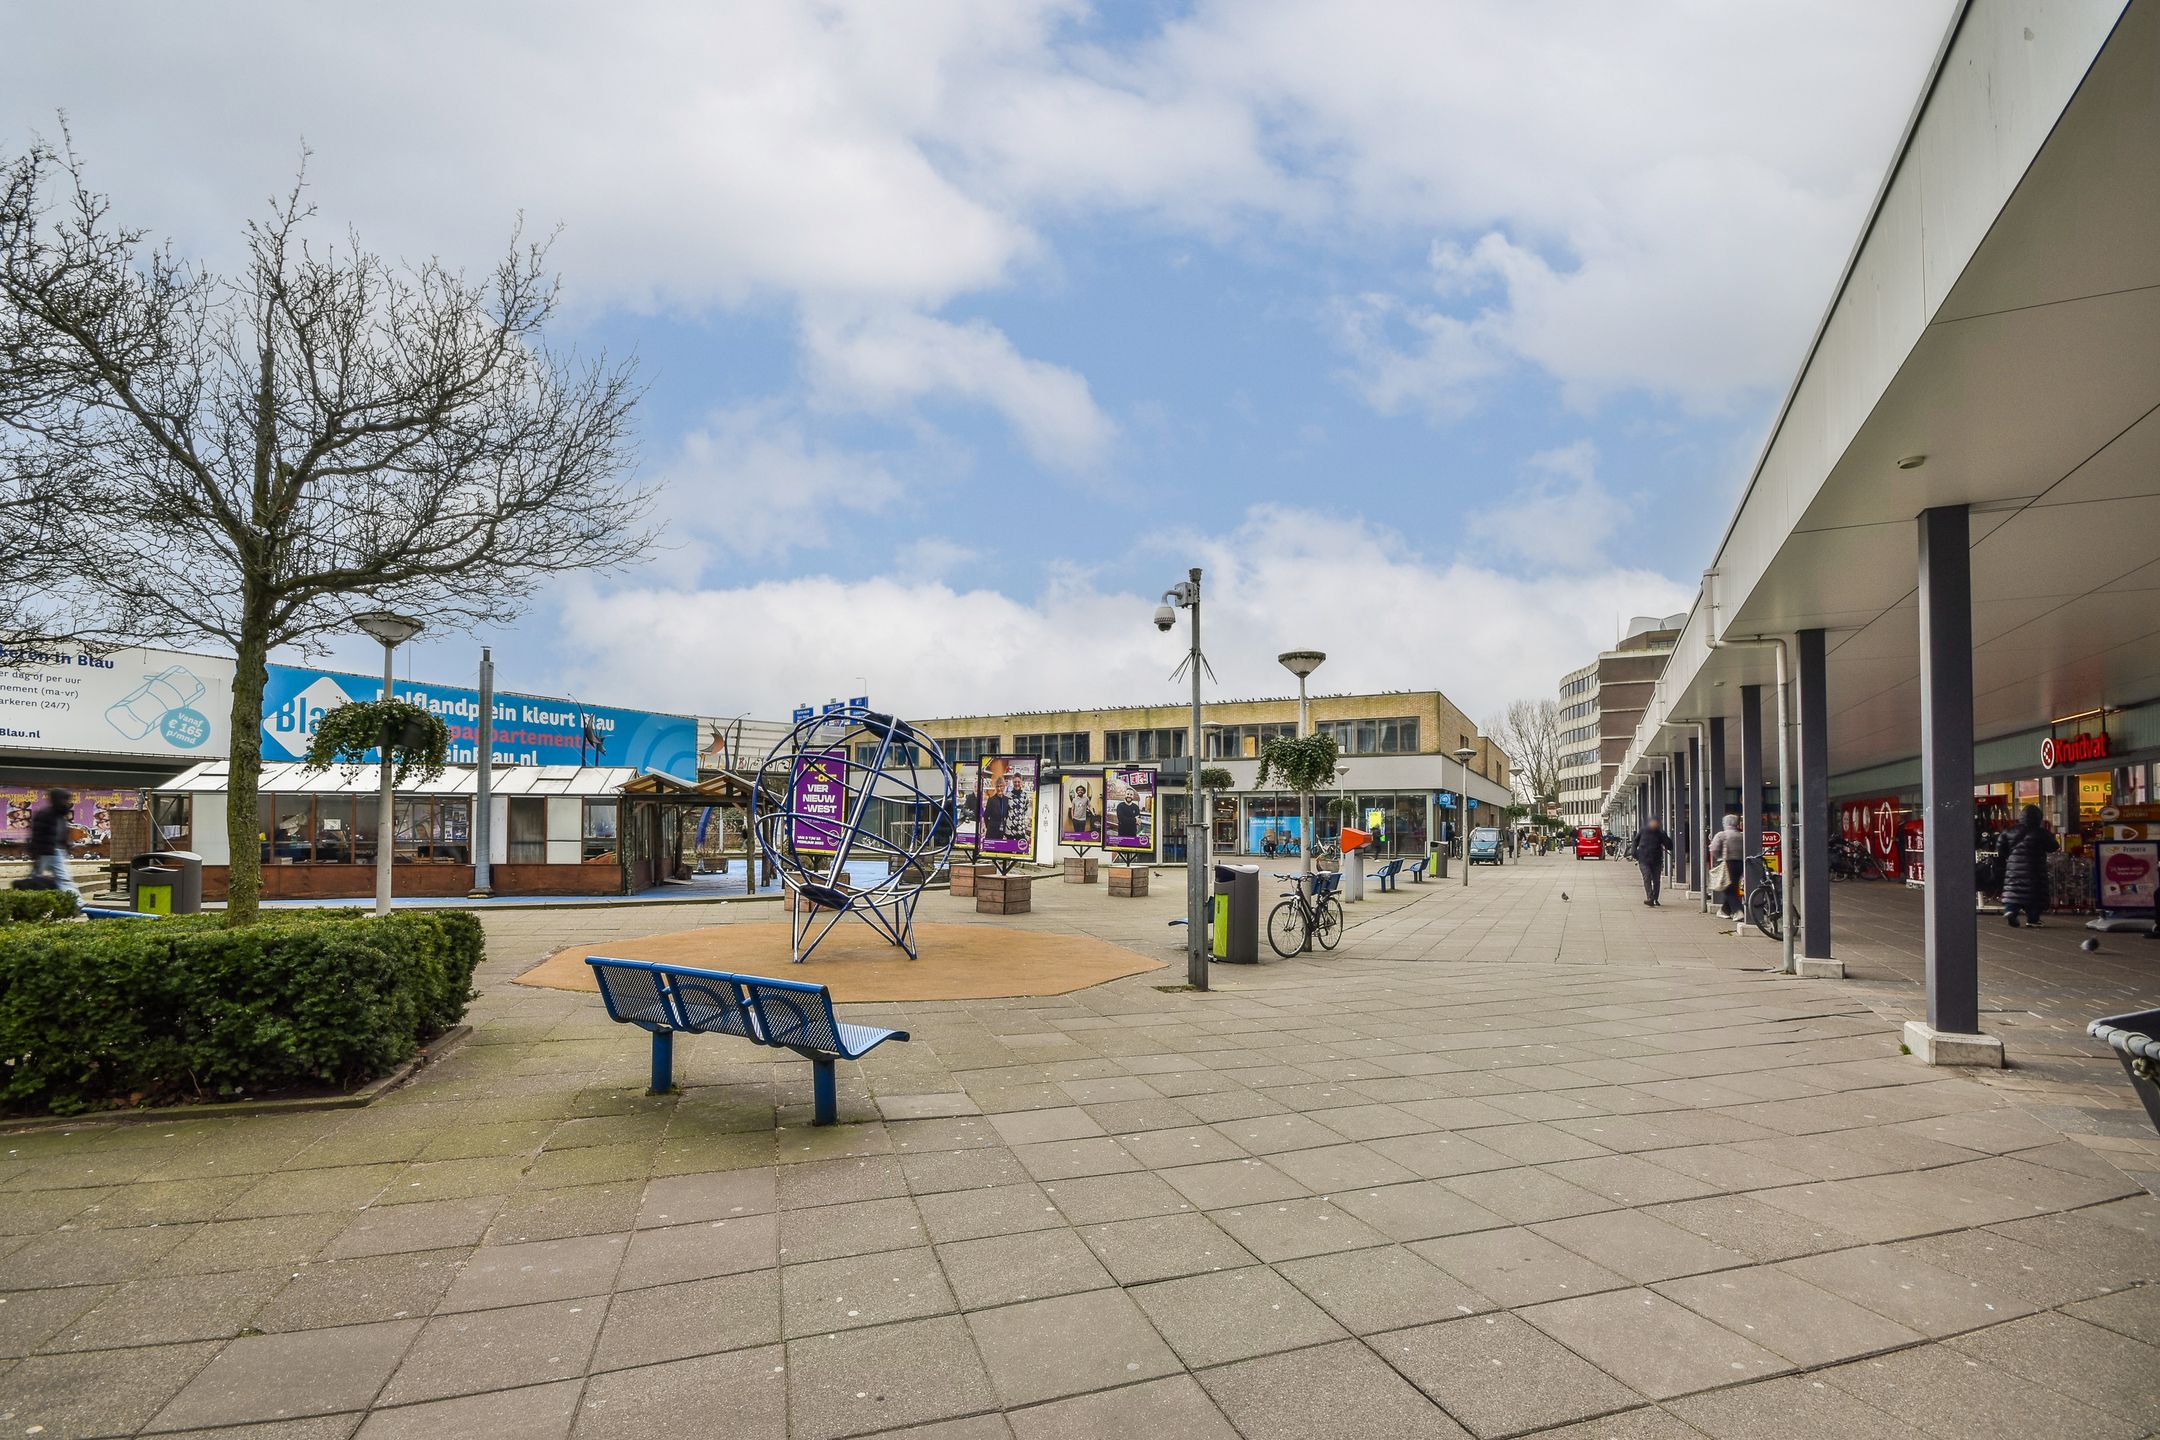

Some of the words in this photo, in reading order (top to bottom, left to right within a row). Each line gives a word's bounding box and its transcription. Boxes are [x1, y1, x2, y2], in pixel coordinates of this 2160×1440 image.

[56, 651, 72, 665] in
[78, 655, 115, 669] Blau
[12, 670, 31, 682] dag
[33, 673, 44, 682] of
[46, 675, 62, 684] per
[41, 687, 80, 699] (ma-vr)
[40, 700, 71, 711] (24/7)
[178, 712, 204, 727] Vanaf
[277, 697, 328, 736] Bla
[523, 705, 576, 728] kleurt
[166, 730, 197, 745] p/mnd
[179, 723, 204, 738] 165
[2054, 733, 2110, 765] Kruidvat
[807, 784, 829, 793] VIER
[803, 794, 836, 804] NIEUW
[804, 804, 838, 814] -WEST
